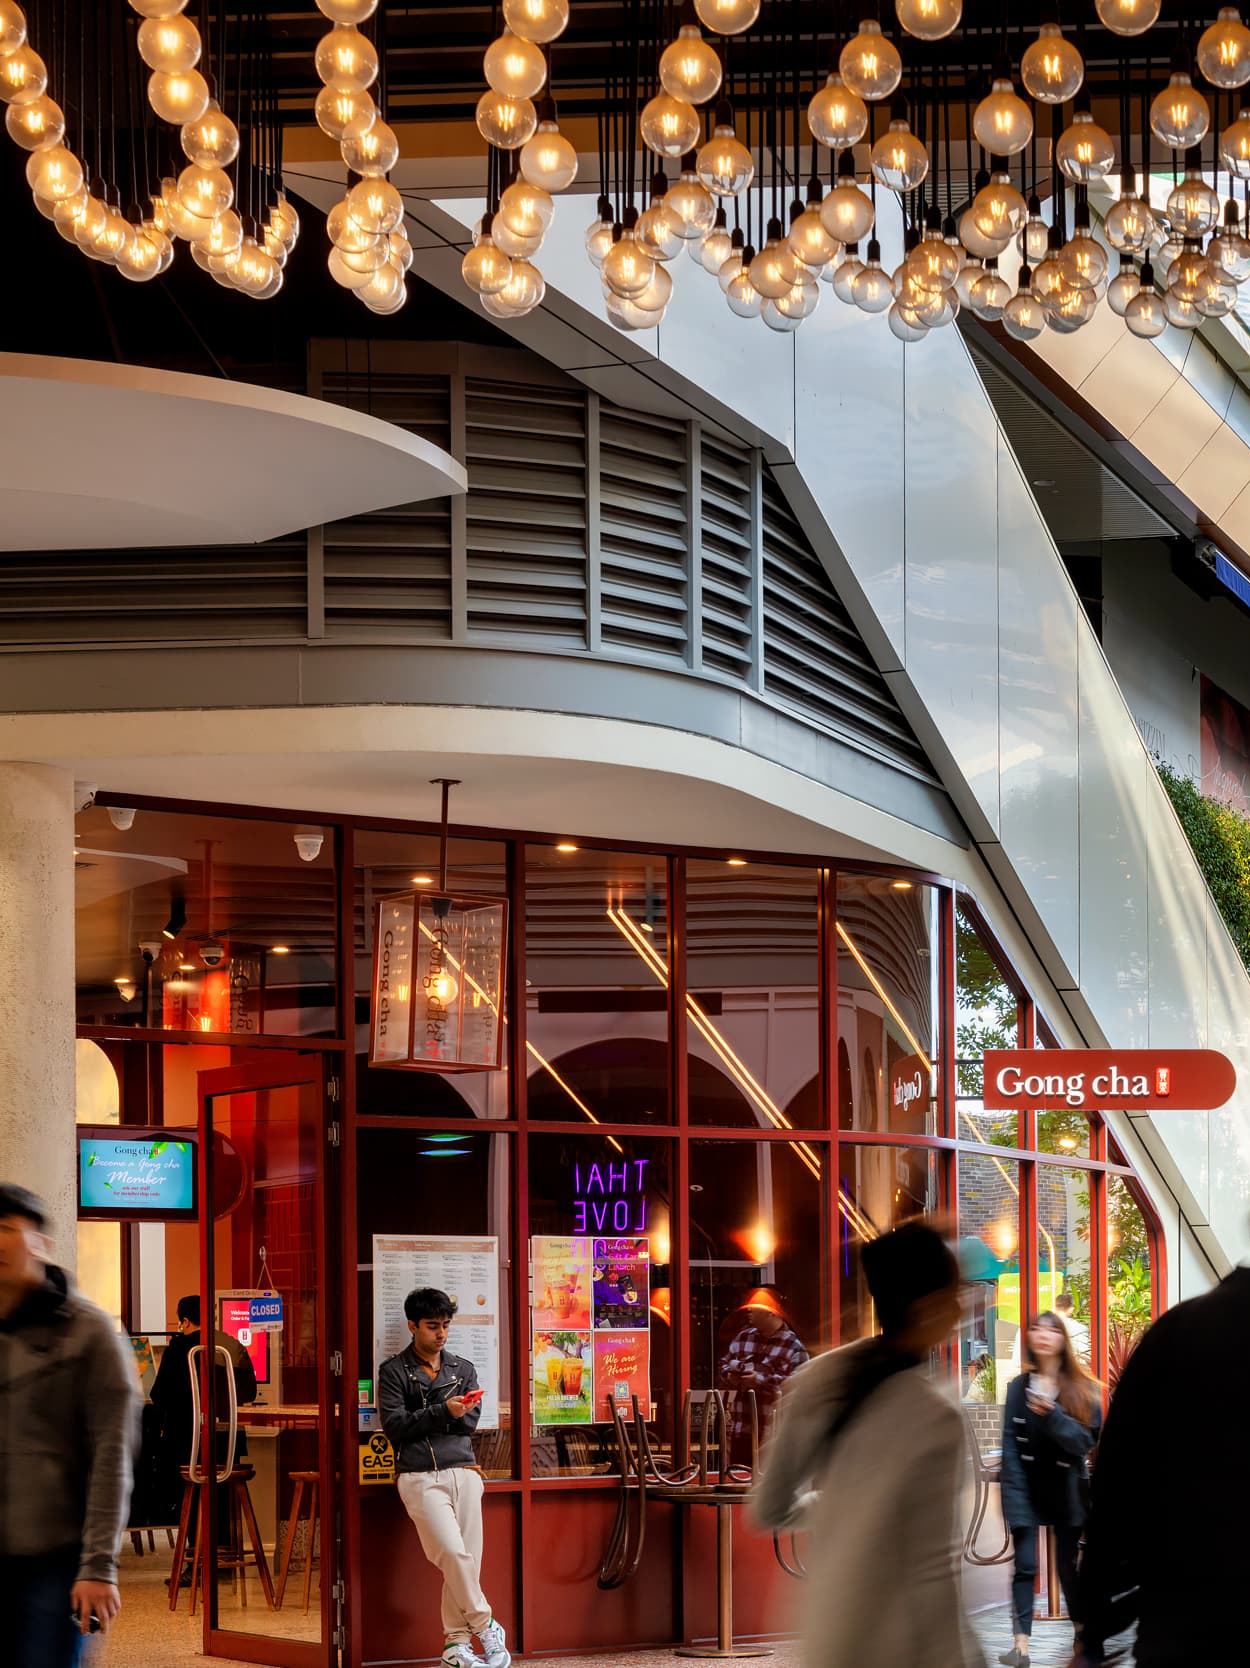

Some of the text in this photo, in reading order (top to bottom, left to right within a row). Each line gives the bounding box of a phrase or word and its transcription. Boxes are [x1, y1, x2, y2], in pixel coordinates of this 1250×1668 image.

[380, 930, 393, 1036] Gong cha
[996, 1066, 1150, 1105] Gong cha
[114, 1145, 153, 1156] Gong cha
[93, 1155, 125, 1167] Become
[138, 1158, 161, 1172] Gong
[163, 1159, 181, 1168] cha
[106, 1168, 167, 1185] Member
[250, 1304, 280, 1316] CLOSED
[603, 1353, 618, 1365] We
[606, 1364, 638, 1376] Hiring
[362, 1455, 393, 1468] EAS
